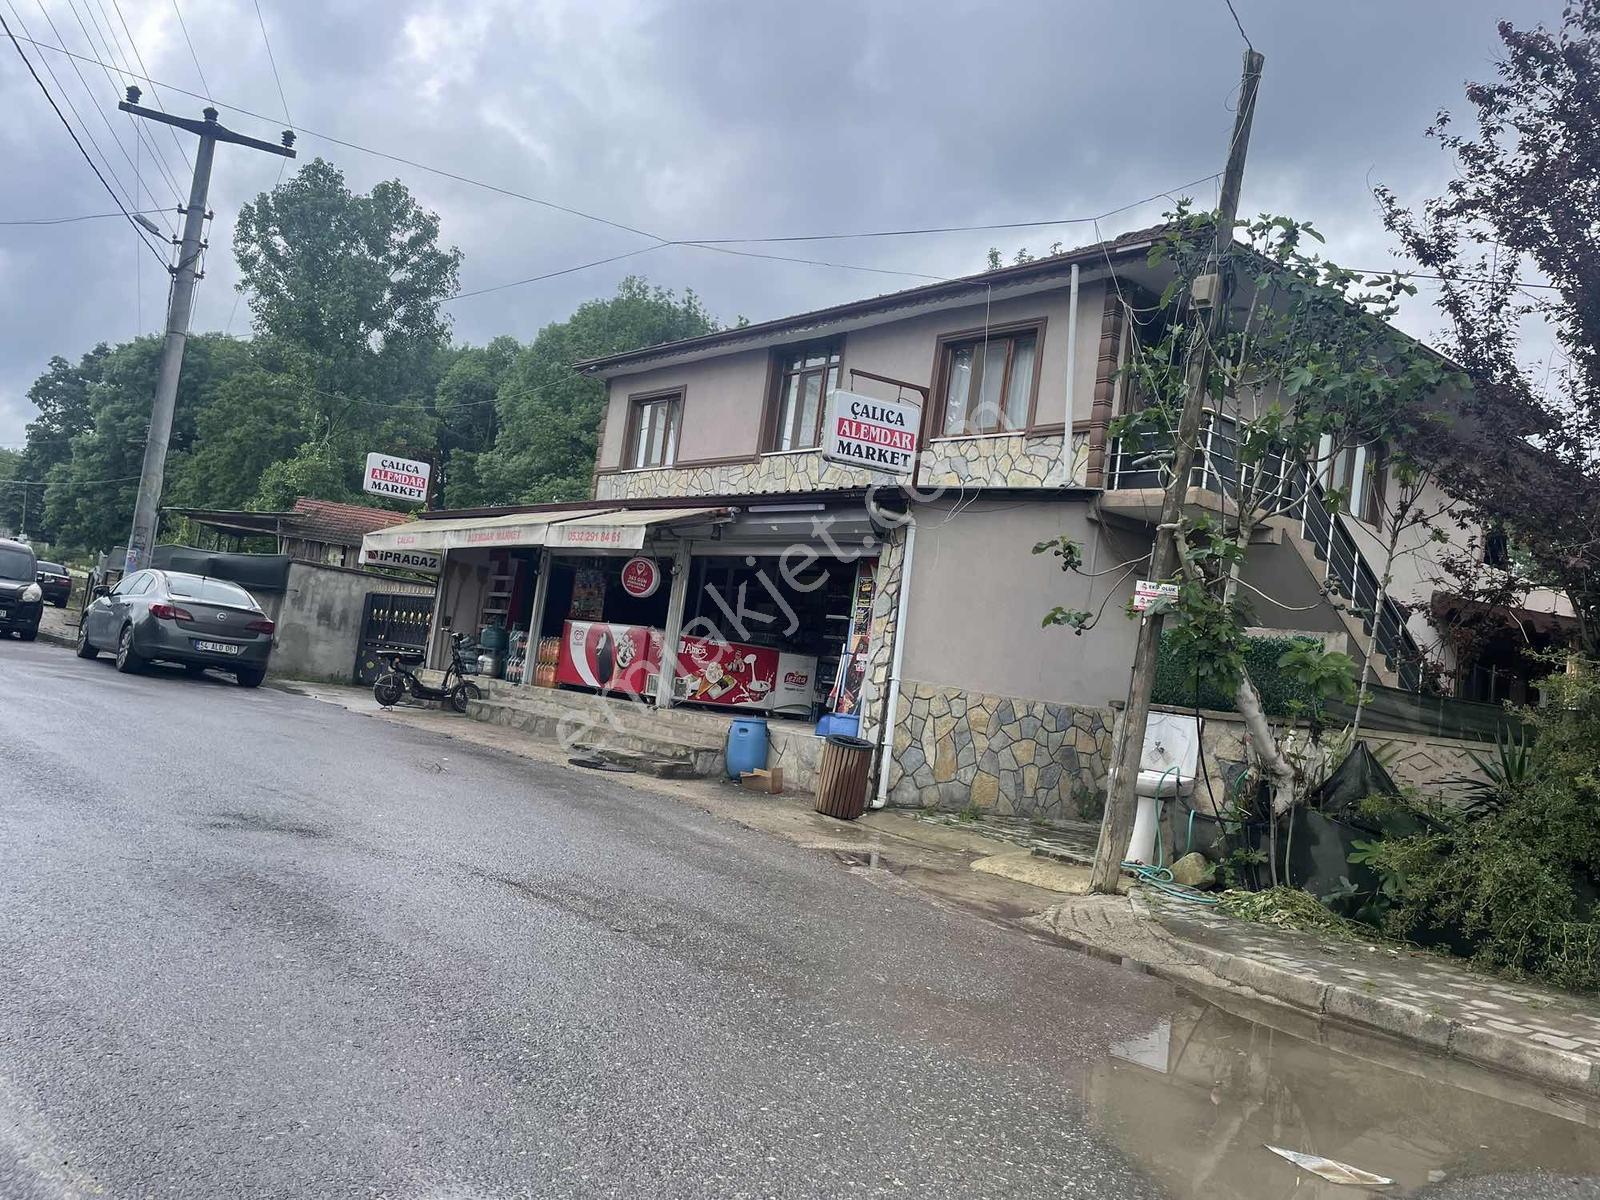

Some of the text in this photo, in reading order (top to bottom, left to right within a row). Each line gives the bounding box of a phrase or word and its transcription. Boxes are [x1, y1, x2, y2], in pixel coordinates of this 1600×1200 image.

[850, 401, 905, 426] ÇALICA
[839, 420, 912, 452] ALEMDAR
[836, 440, 911, 467] MARKET
[381, 459, 419, 474] ÇALICA
[372, 469, 425, 488] ALEMDAR
[371, 481, 424, 498] MARKET
[567, 531, 585, 542] 0532
